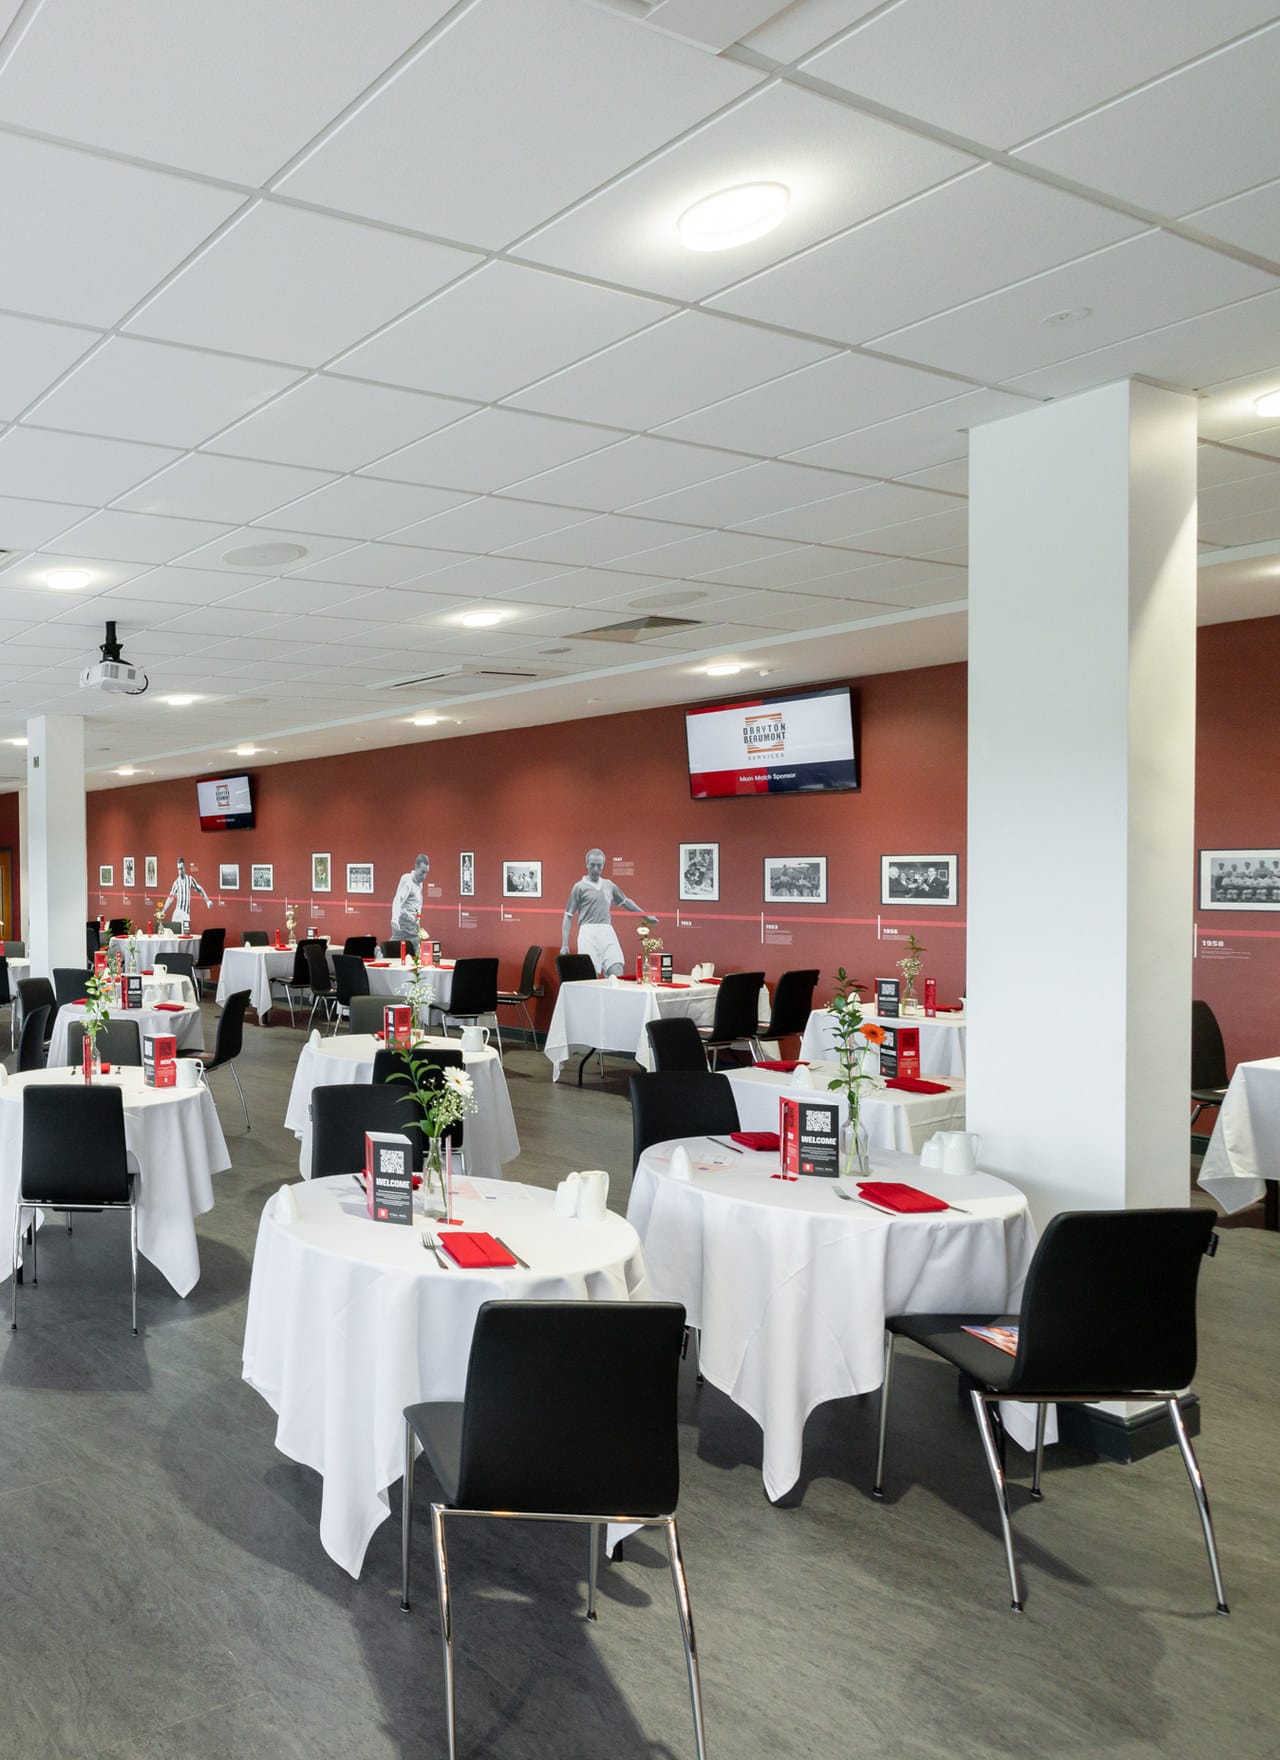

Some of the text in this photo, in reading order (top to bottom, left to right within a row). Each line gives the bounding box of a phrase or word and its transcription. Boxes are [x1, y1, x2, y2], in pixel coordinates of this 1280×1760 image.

[743, 723, 786, 735] DRAYTON
[743, 732, 786, 744] BEAUMONT
[754, 773, 772, 781] Match
[772, 772, 797, 781] Sponsor
[801, 1135, 837, 1146] WELCOME
[375, 1177, 411, 1189] WELCOME
